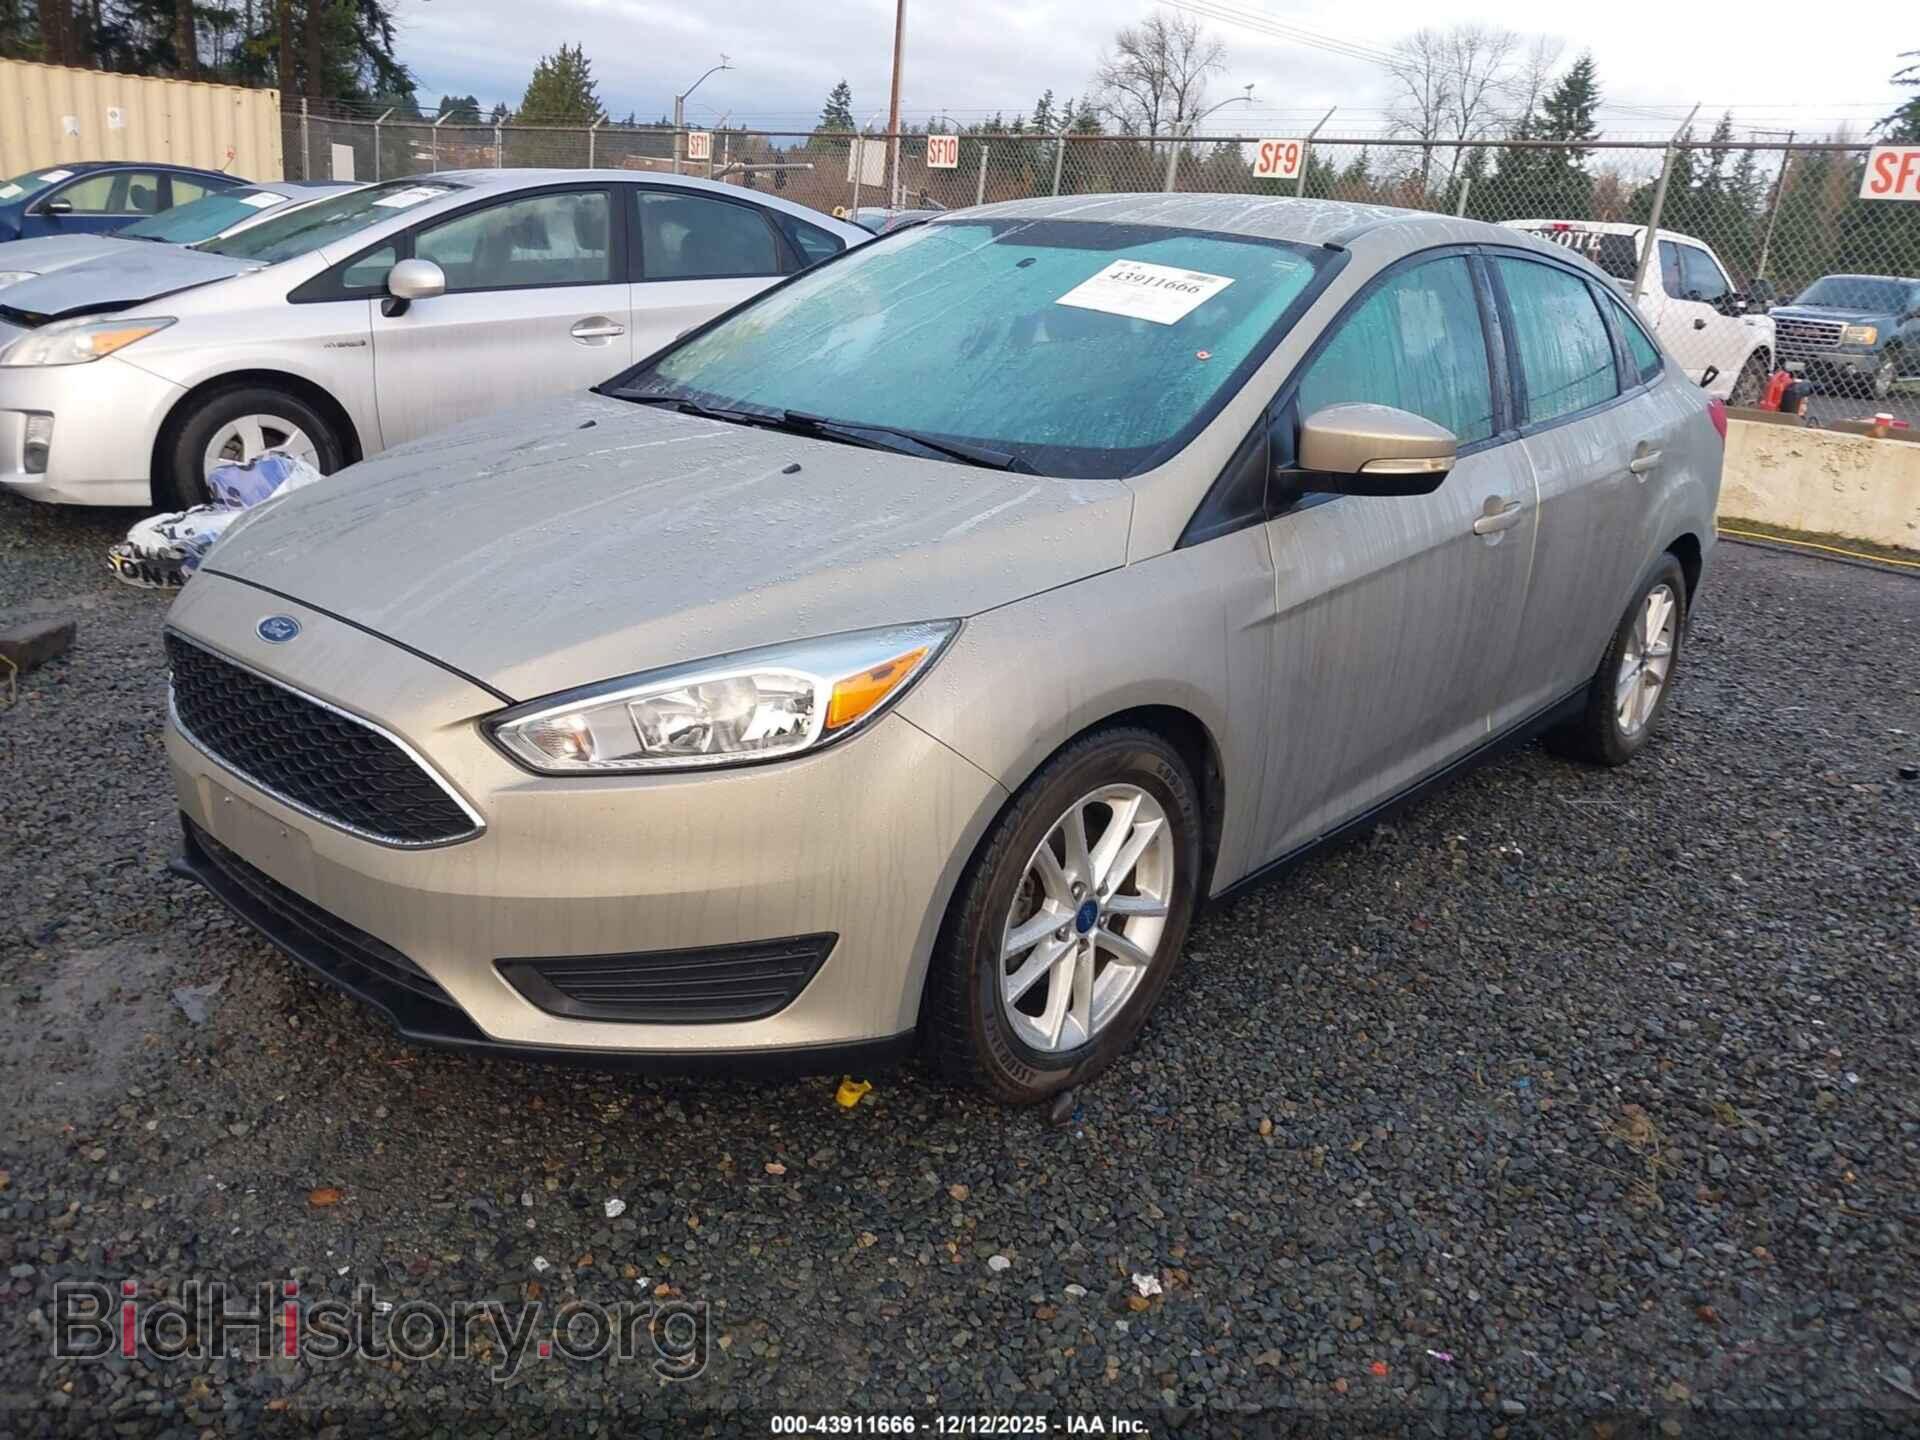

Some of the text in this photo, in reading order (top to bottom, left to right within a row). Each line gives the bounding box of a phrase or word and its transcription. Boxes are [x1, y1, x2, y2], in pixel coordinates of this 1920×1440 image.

[690, 135, 708, 156] SF11
[930, 139, 956, 163] SF10
[1259, 143, 1298, 174] SF9
[1871, 152, 1920, 193] SF
[1109, 270, 1201, 294] 43911666
